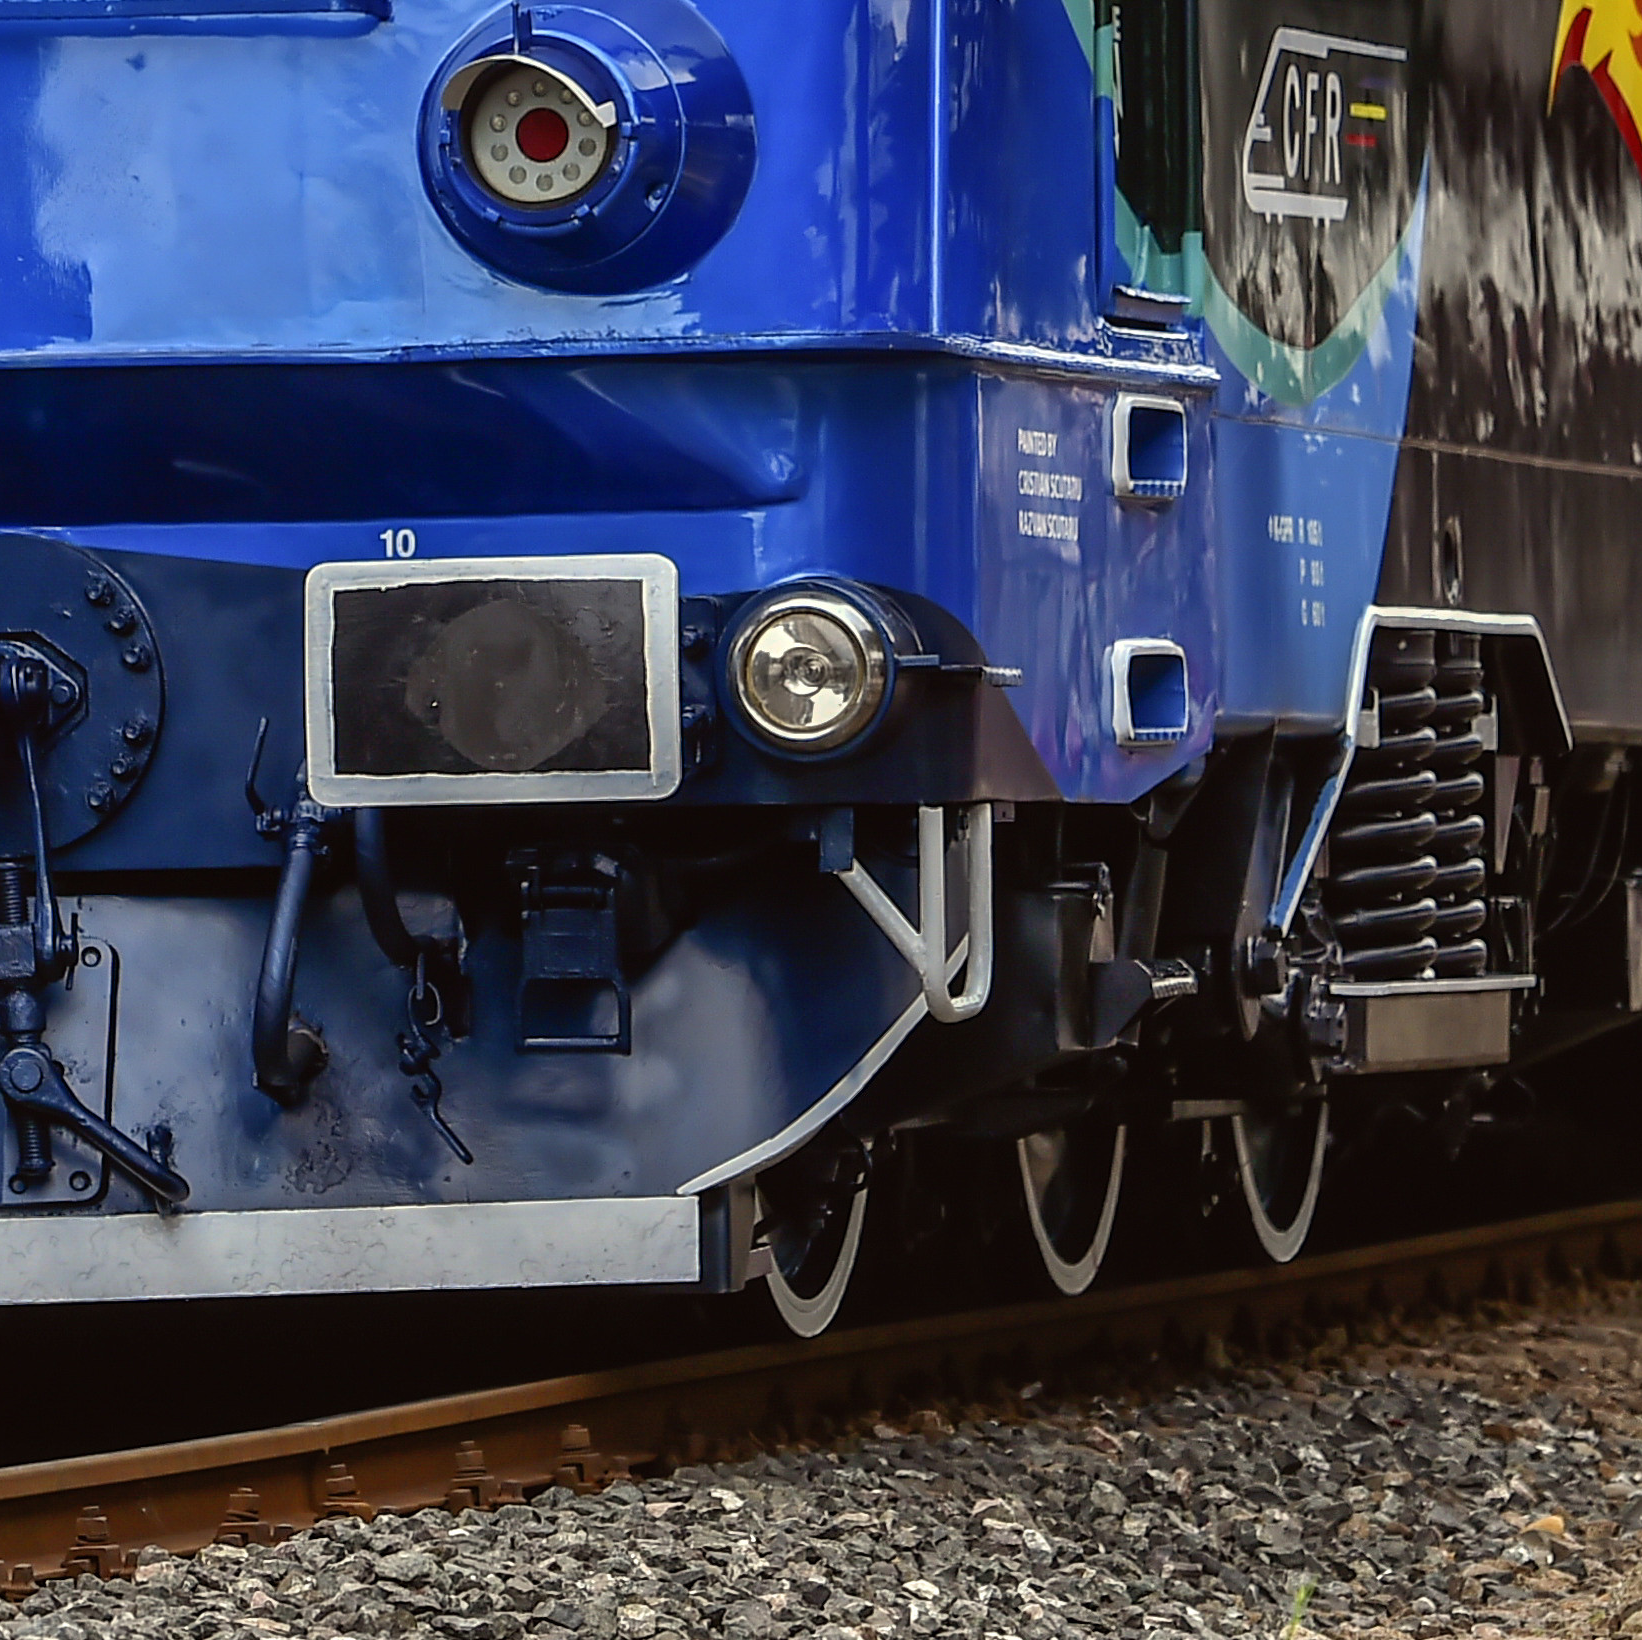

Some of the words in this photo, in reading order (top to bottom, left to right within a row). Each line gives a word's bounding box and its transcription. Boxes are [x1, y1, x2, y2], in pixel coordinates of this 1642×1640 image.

[1283, 64, 1341, 185] CFR
[379, 529, 416, 558] 10
[1299, 558, 1306, 584] P
